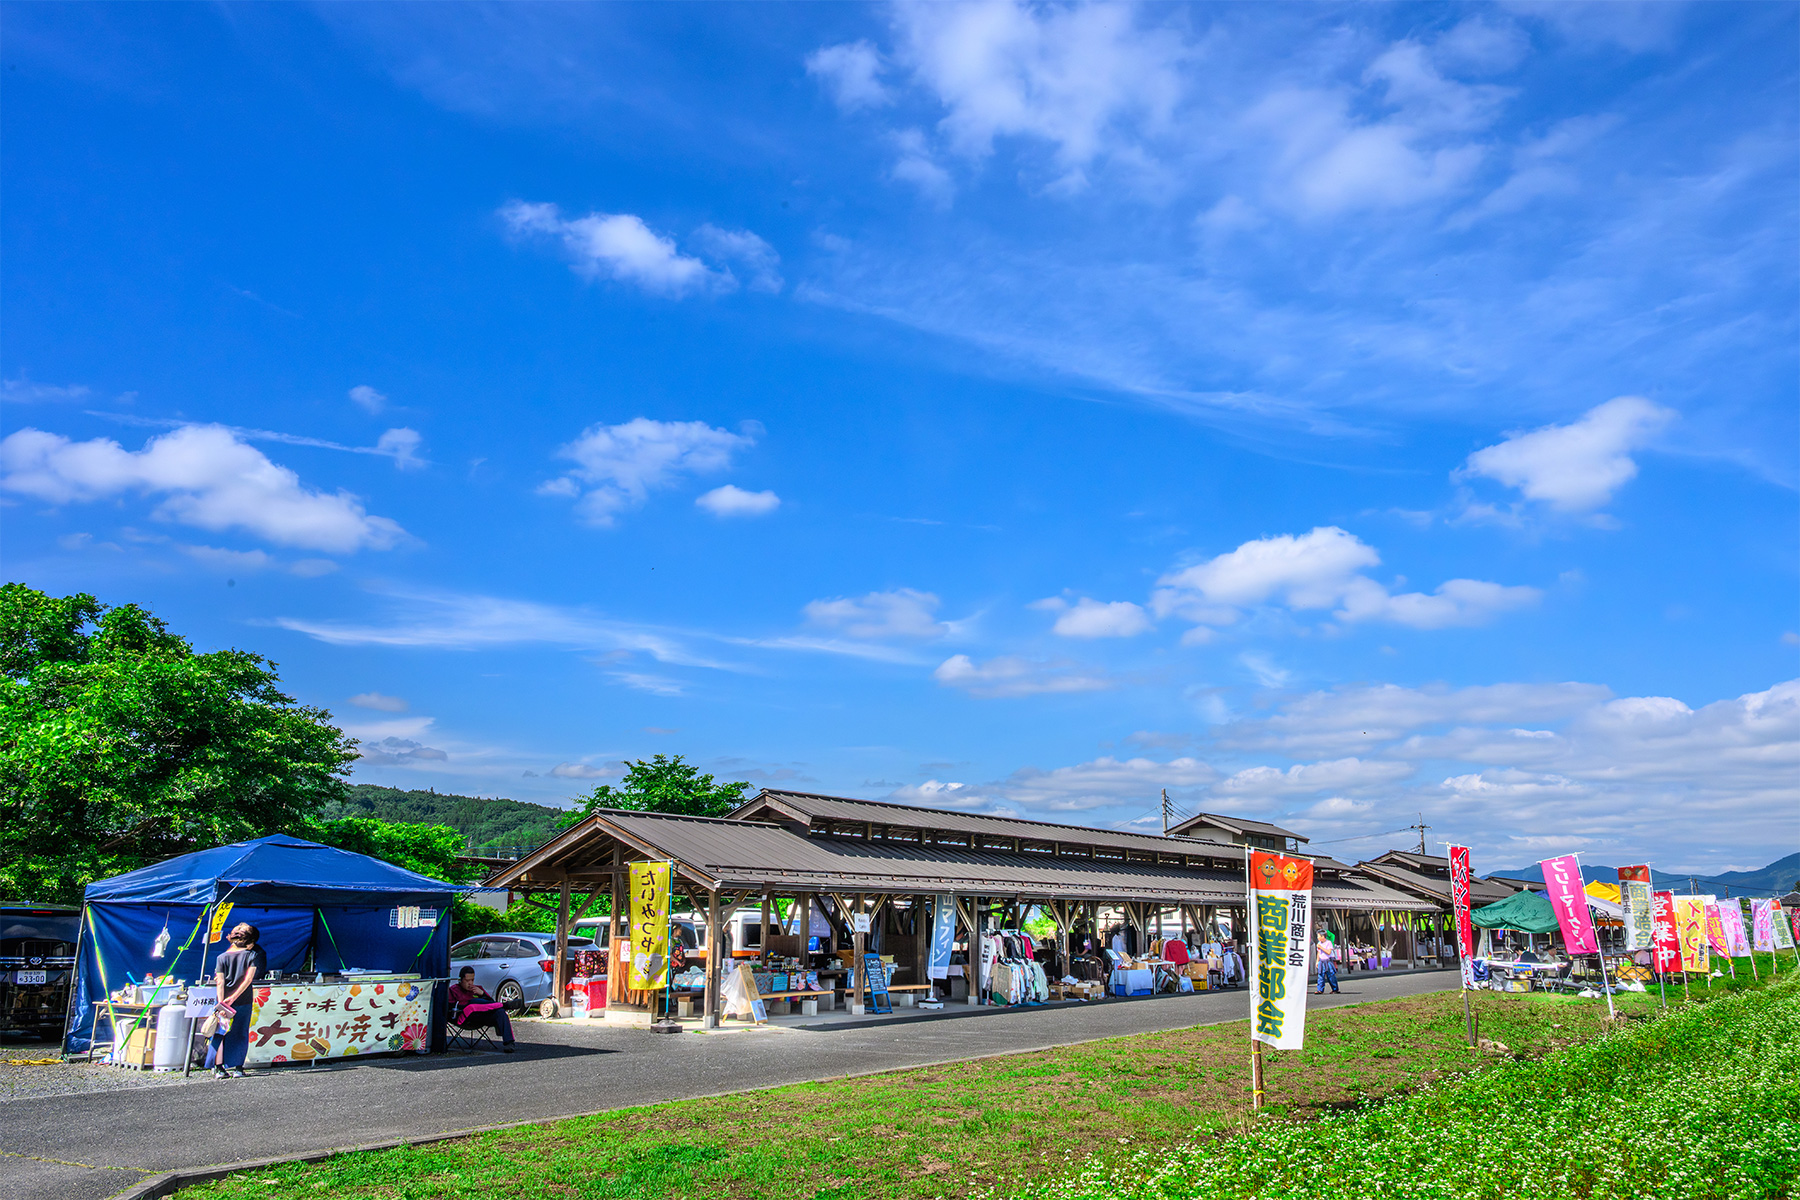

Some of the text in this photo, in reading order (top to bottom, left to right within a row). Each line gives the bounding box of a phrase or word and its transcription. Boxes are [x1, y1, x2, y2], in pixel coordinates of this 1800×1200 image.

[1289, 893, 1306, 967] 荒川商工会
[1652, 896, 1676, 968] 営業中
[1256, 894, 1290, 1039] 商業部会
[255, 1011, 400, 1047] 大判焼き
[276, 997, 396, 1017] 美味しい
